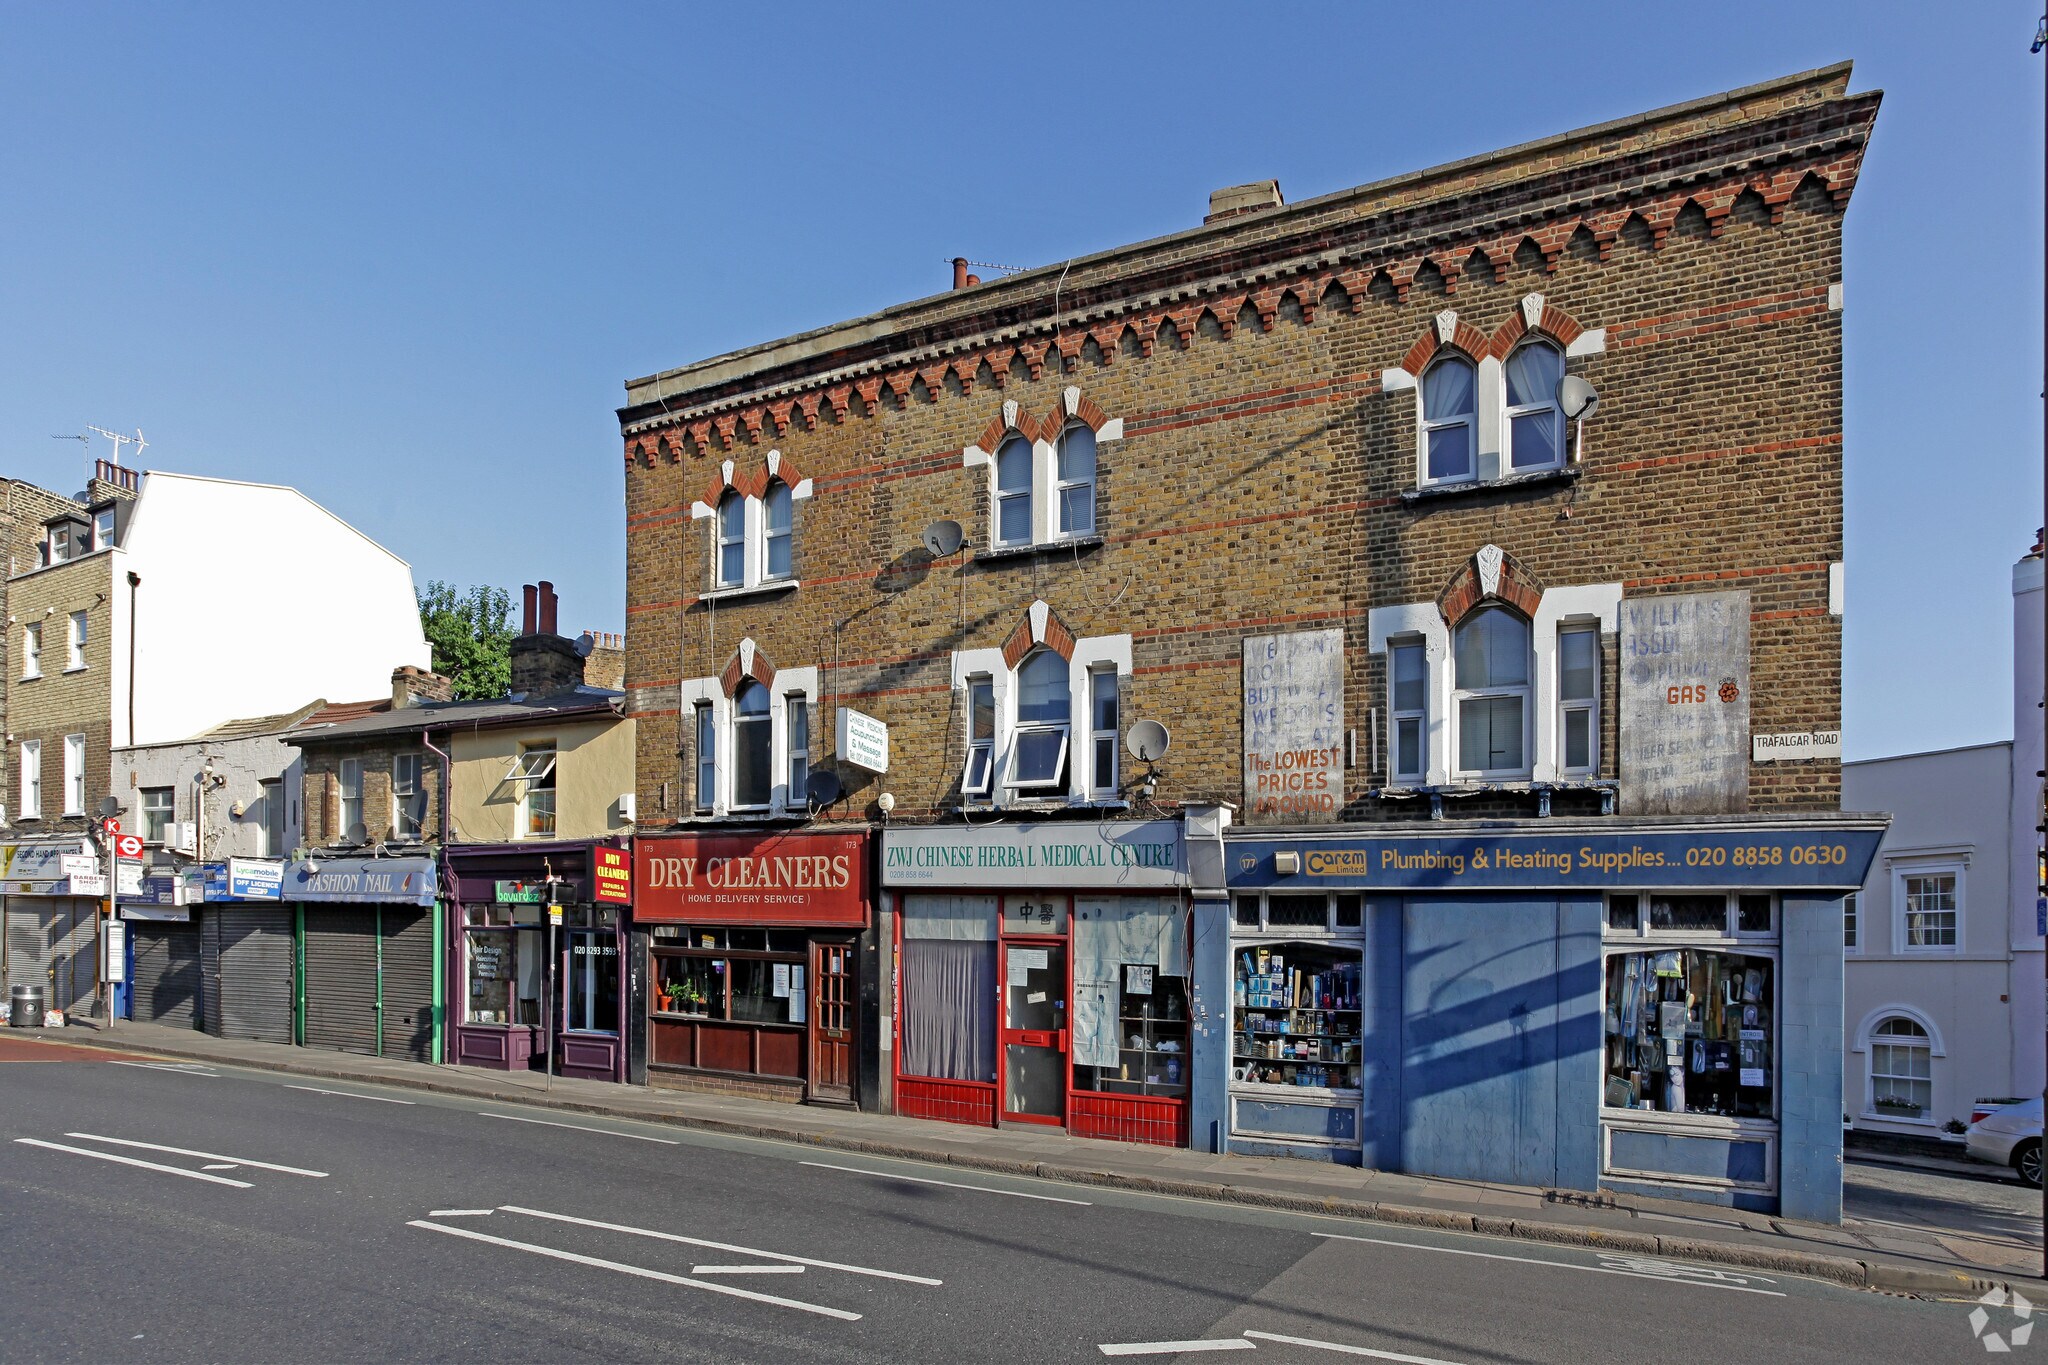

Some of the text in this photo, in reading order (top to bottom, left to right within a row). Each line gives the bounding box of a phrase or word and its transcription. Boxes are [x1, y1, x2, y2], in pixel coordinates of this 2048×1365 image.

[1247, 685, 1280, 706] BUT
[1667, 684, 1707, 705] GAS
[1252, 707, 1278, 727] WE
[850, 725, 883, 746] Acupuncture
[1756, 733, 1838, 748] TRAFALGAR ROAD
[858, 741, 882, 759] Massage
[1247, 747, 1341, 772] The LOWEST
[1257, 771, 1328, 793] PRICES
[1253, 793, 1335, 815] AROUND
[108, 821, 117, 832] K
[644, 841, 857, 853] 173 173
[17, 850, 35, 859] SECOND
[36, 849, 49, 858] HAND
[605, 853, 621, 865] DRY
[887, 846, 914, 868] ZWJ
[916, 846, 974, 868] CHINESE
[1041, 844, 1106, 867] MEDICAL
[1111, 843, 1175, 867] CENTRE
[1382, 850, 1465, 875] Plumbing
[1471, 847, 1489, 869] &
[1495, 848, 1572, 874] Heating
[1685, 847, 1726, 866] 020
[1732, 846, 1783, 866] 8858
[1789, 845, 1847, 865] 0630
[1241, 857, 1256, 869] 177
[1308, 852, 1365, 874] Carem Limited
[235, 866, 279, 877] Lycamobile
[597, 866, 629, 880] CLEANERS
[649, 855, 850, 889] DRY CLEANERS
[889, 870, 933, 879] 0208 858 6644
[251, 881, 279, 889] LICENCE
[306, 873, 393, 893] FASHION NAIL
[602, 882, 620, 890] REPAIRS
[600, 890, 627, 898] ALTERATIONS
[715, 894, 761, 904] DELIVERY
[471, 945, 502, 957] Hair Design
[574, 946, 617, 956] 020 8293 3593
[477, 962, 497, 972] Colouring
[478, 970, 496, 979] Perming
